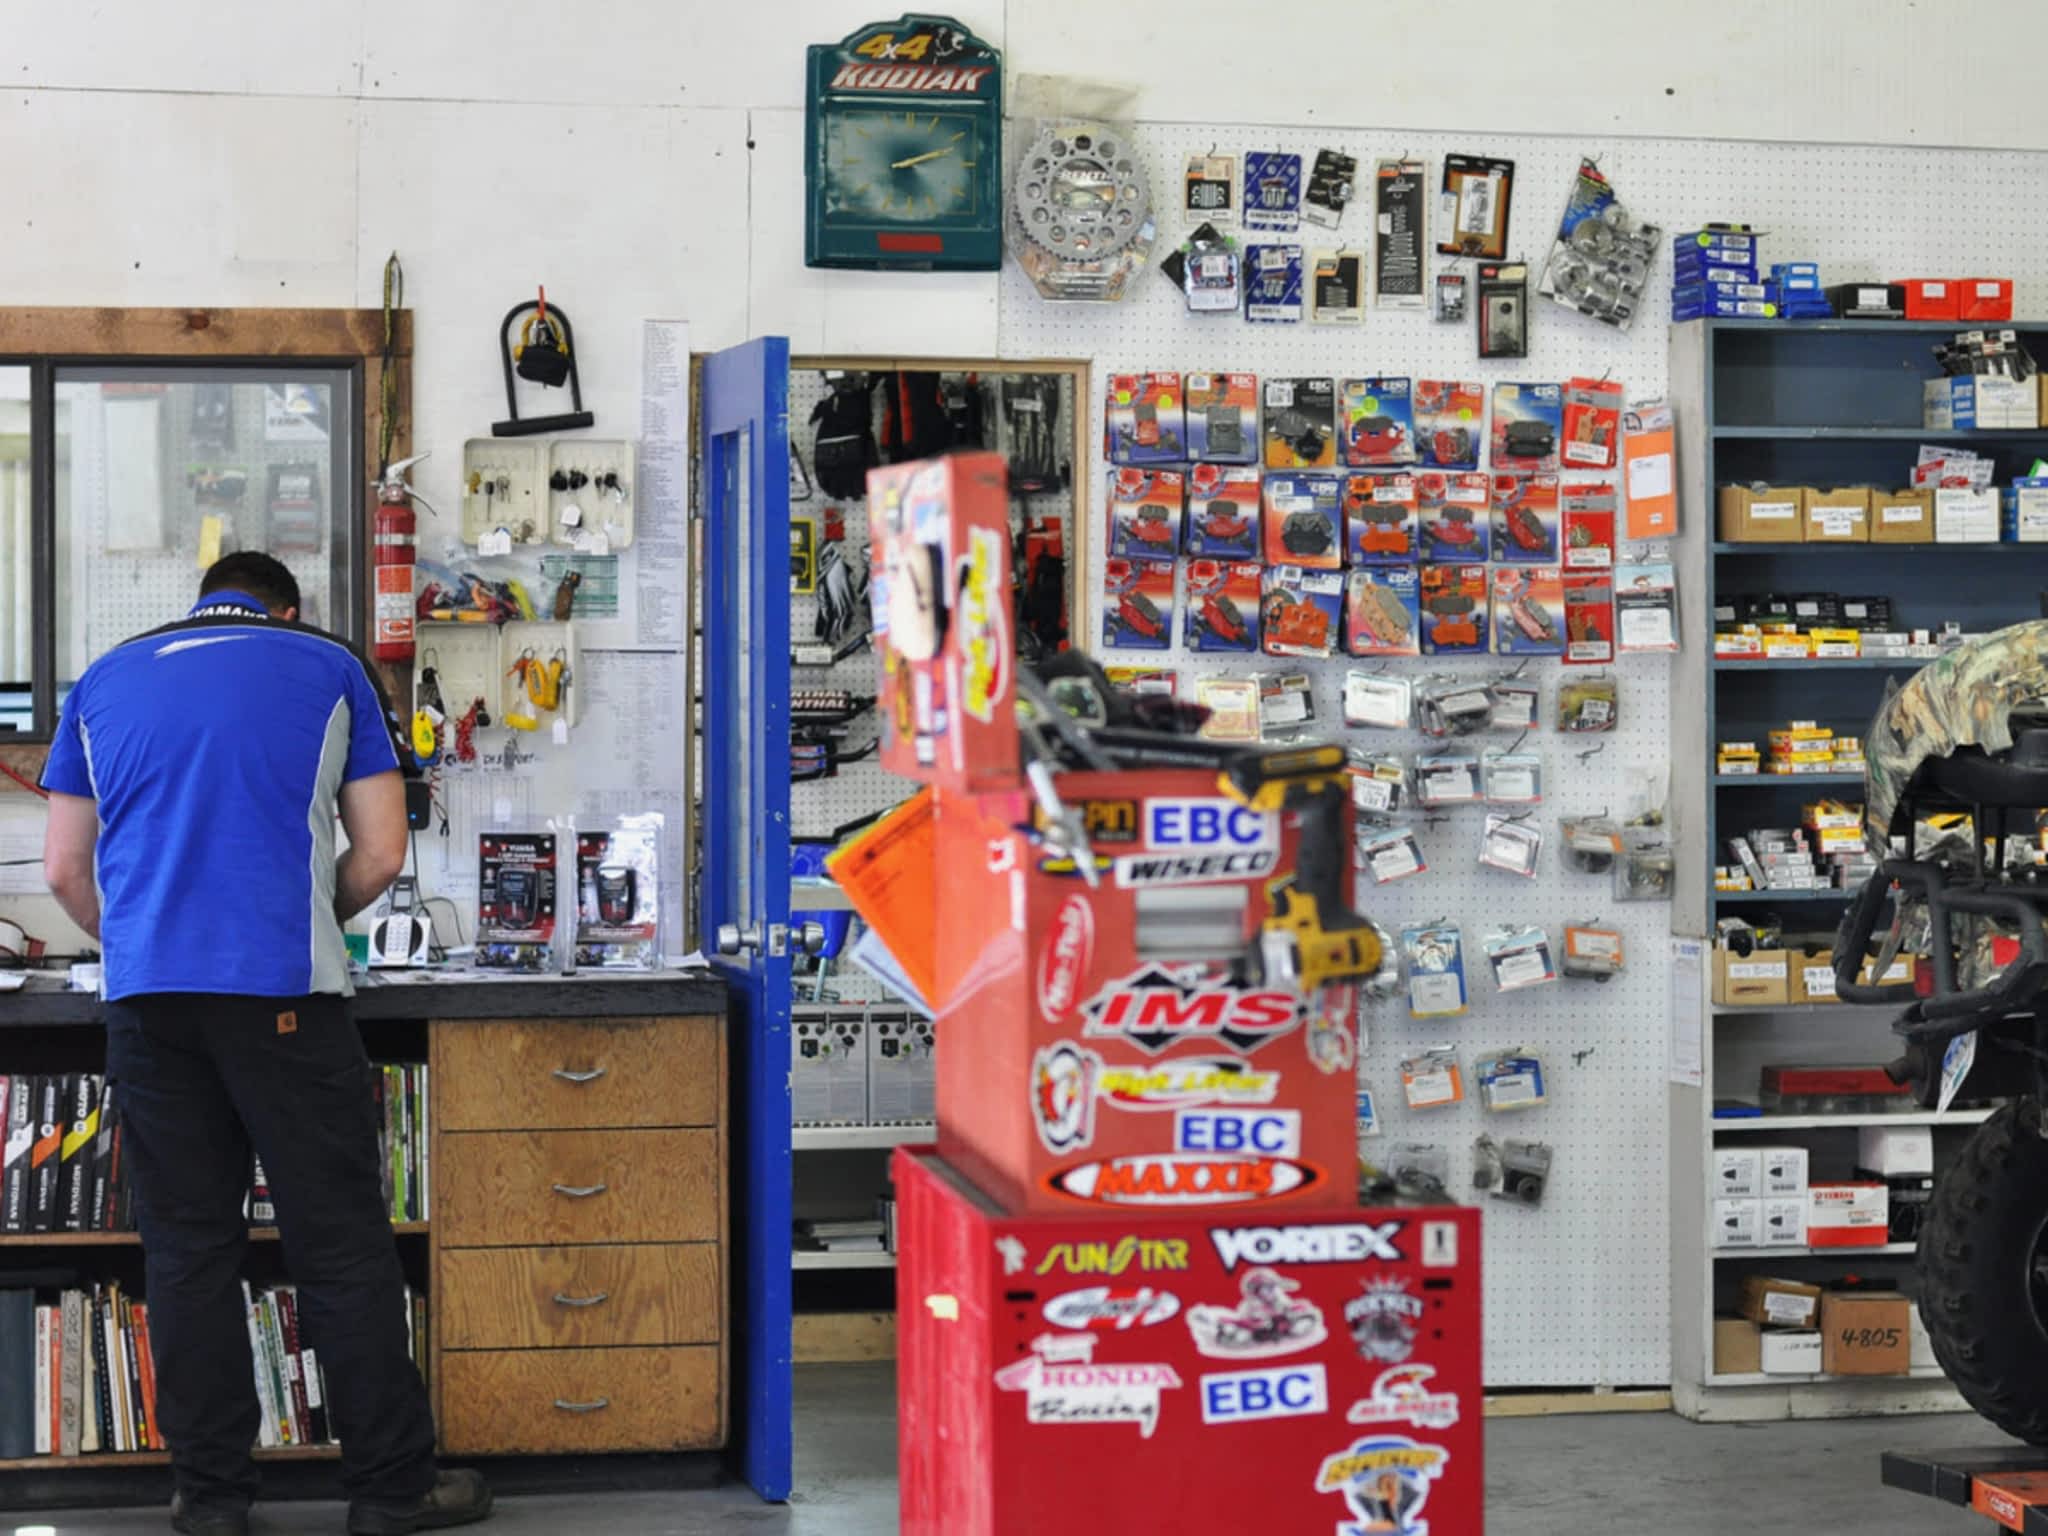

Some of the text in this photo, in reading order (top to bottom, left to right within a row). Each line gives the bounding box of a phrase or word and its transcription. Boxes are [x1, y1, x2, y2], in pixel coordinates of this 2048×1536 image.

[856, 34, 932, 60] 4x4
[830, 65, 990, 92] KODIAK
[1309, 380, 1331, 391] EBC
[791, 699, 847, 709] NTHAL
[1152, 806, 1262, 844] EBC
[1130, 851, 1272, 880] WISECO
[1101, 992, 1298, 1027] IMS
[1180, 1115, 1285, 1152] EBC
[70, 1165, 82, 1214] MOTOVAN
[1094, 1160, 1276, 1196] MAXXIS
[1211, 1223, 1402, 1270] VORTEX
[1041, 1369, 1175, 1388] HONDA
[1031, 1394, 1154, 1424] Racing
[1207, 1374, 1313, 1418] EBC
